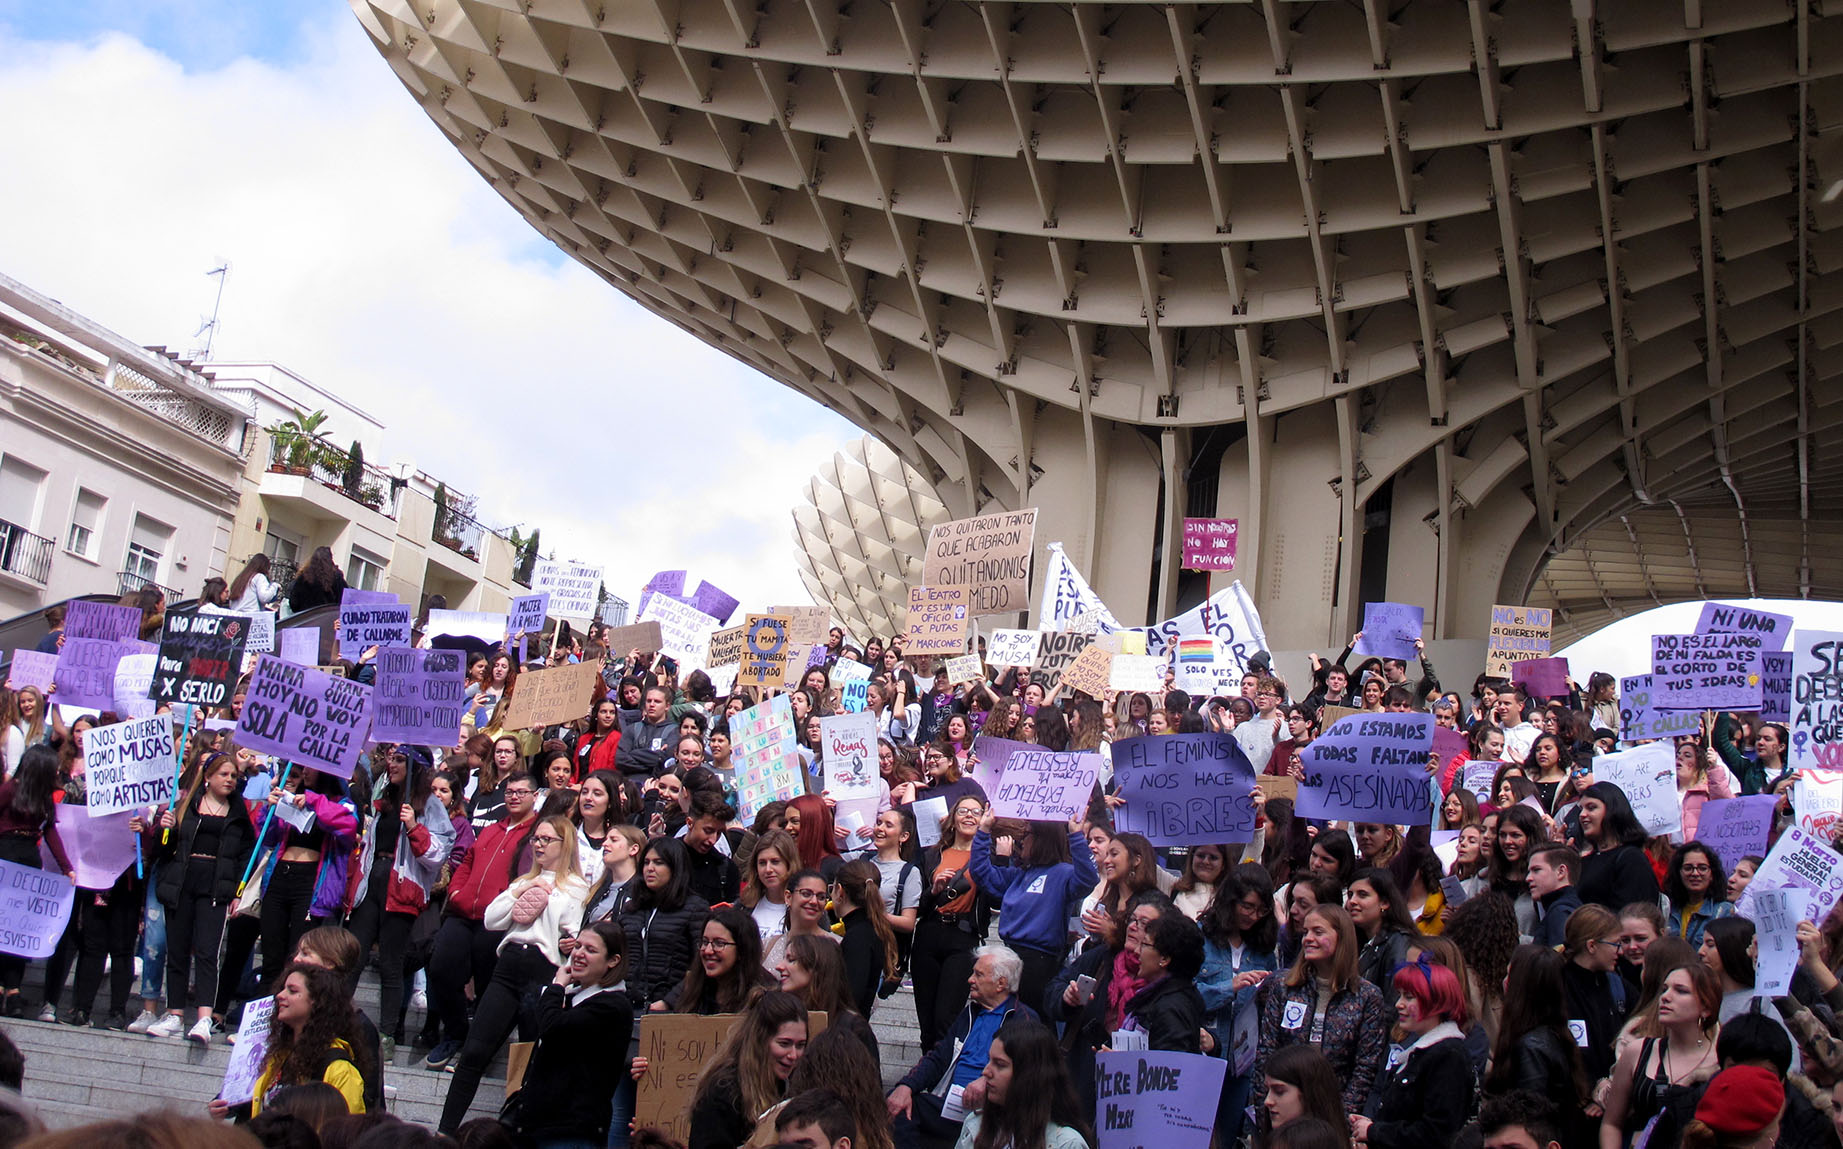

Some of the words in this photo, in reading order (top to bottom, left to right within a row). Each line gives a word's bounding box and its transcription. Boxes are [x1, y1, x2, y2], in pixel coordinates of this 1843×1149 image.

[932, 525, 951, 539] NOS
[1005, 512, 1035, 527] TANTO
[1186, 523, 1205, 533] SIN
[937, 538, 963, 558] QUE
[965, 530, 1021, 553] ACABARON
[1187, 537, 1201, 547] NO
[1212, 537, 1229, 549] HAY
[911, 588, 924, 602] EL
[926, 587, 962, 601] TEATRO
[518, 599, 542, 613] MUJER
[909, 603, 924, 614] NO
[926, 604, 938, 613] ES
[940, 602, 953, 612] UN
[169, 615, 191, 633] NO
[190, 616, 223, 636] NACÍ
[762, 618, 788, 629] FUESE
[1492, 607, 1515, 625] NO
[1514, 616, 1524, 625] es
[1526, 609, 1550, 627] NO
[1738, 612, 1775, 634] UNA
[346, 627, 359, 642] DE
[911, 625, 924, 634] DE
[929, 623, 958, 633] PUTAS
[993, 632, 1008, 643] NO
[1013, 633, 1034, 644] SOY
[1492, 627, 1500, 635] SI
[744, 635, 757, 644] TU
[905, 639, 913, 650] Y
[1658, 635, 1678, 649] NO
[1682, 635, 1700, 649] ES
[1701, 636, 1718, 649] EL
[1721, 635, 1762, 649] LARGO
[159, 655, 183, 673] Para
[743, 652, 754, 661] TE
[756, 652, 787, 663] HUBIERA
[991, 650, 1031, 664] MUSA
[1655, 649, 1673, 661] DE
[1692, 650, 1734, 660] FALDA
[1736, 651, 1755, 662] ES
[742, 666, 781, 678] ABORTADO
[1185, 665, 1207, 675] SOLO
[1212, 668, 1233, 678] VES
[1654, 664, 1668, 675] EL
[1671, 662, 1718, 675] CORTO
[1727, 662, 1747, 674] DE
[160, 676, 177, 697] X
[180, 679, 226, 705] SERLO
[847, 683, 866, 699] NO
[1665, 677, 1693, 692] TUS
[1700, 675, 1746, 688] IDEAS
[256, 679, 295, 703] HOY
[289, 692, 319, 719] NO
[326, 704, 362, 729] VOY
[324, 687, 365, 714] QUILA
[242, 701, 289, 744] SOLA
[303, 718, 328, 740] POR
[331, 728, 351, 747] LA
[1326, 722, 1353, 738] NO
[1358, 720, 1427, 741] ESTAMOS
[1652, 712, 1699, 733] CALLAS
[91, 728, 116, 749] NOS
[123, 718, 166, 742] QUIEREN
[88, 748, 115, 769] COMO
[119, 734, 173, 764] MUSAS
[298, 736, 347, 766] CALLE
[833, 737, 869, 758] Reinas
[1130, 743, 1157, 769] EL
[1313, 745, 1358, 765] TODAS
[1371, 746, 1431, 766] FALTAN
[1006, 750, 1082, 772] RESISTENCIA
[1634, 761, 1650, 776] ARE
[94, 765, 127, 788] PORQUE
[1140, 773, 1180, 790] NOS
[1195, 772, 1234, 787] HACE
[1303, 772, 1324, 788] LAS
[90, 788, 111, 808] COMO
[998, 783, 1065, 804] EXISTENCIA
[1790, 828, 1803, 842] 8
[1801, 836, 1838, 868] Marzo
[1779, 854, 1825, 889] ESTUDIANTIL
[1789, 852, 1828, 883] GENERAL
[1798, 848, 1833, 876] HUELGA
[12, 870, 60, 898] DECIDO
[248, 1002, 257, 1014] 8
[650, 1029, 667, 1063] Ni
[677, 1039, 706, 1065] soy
